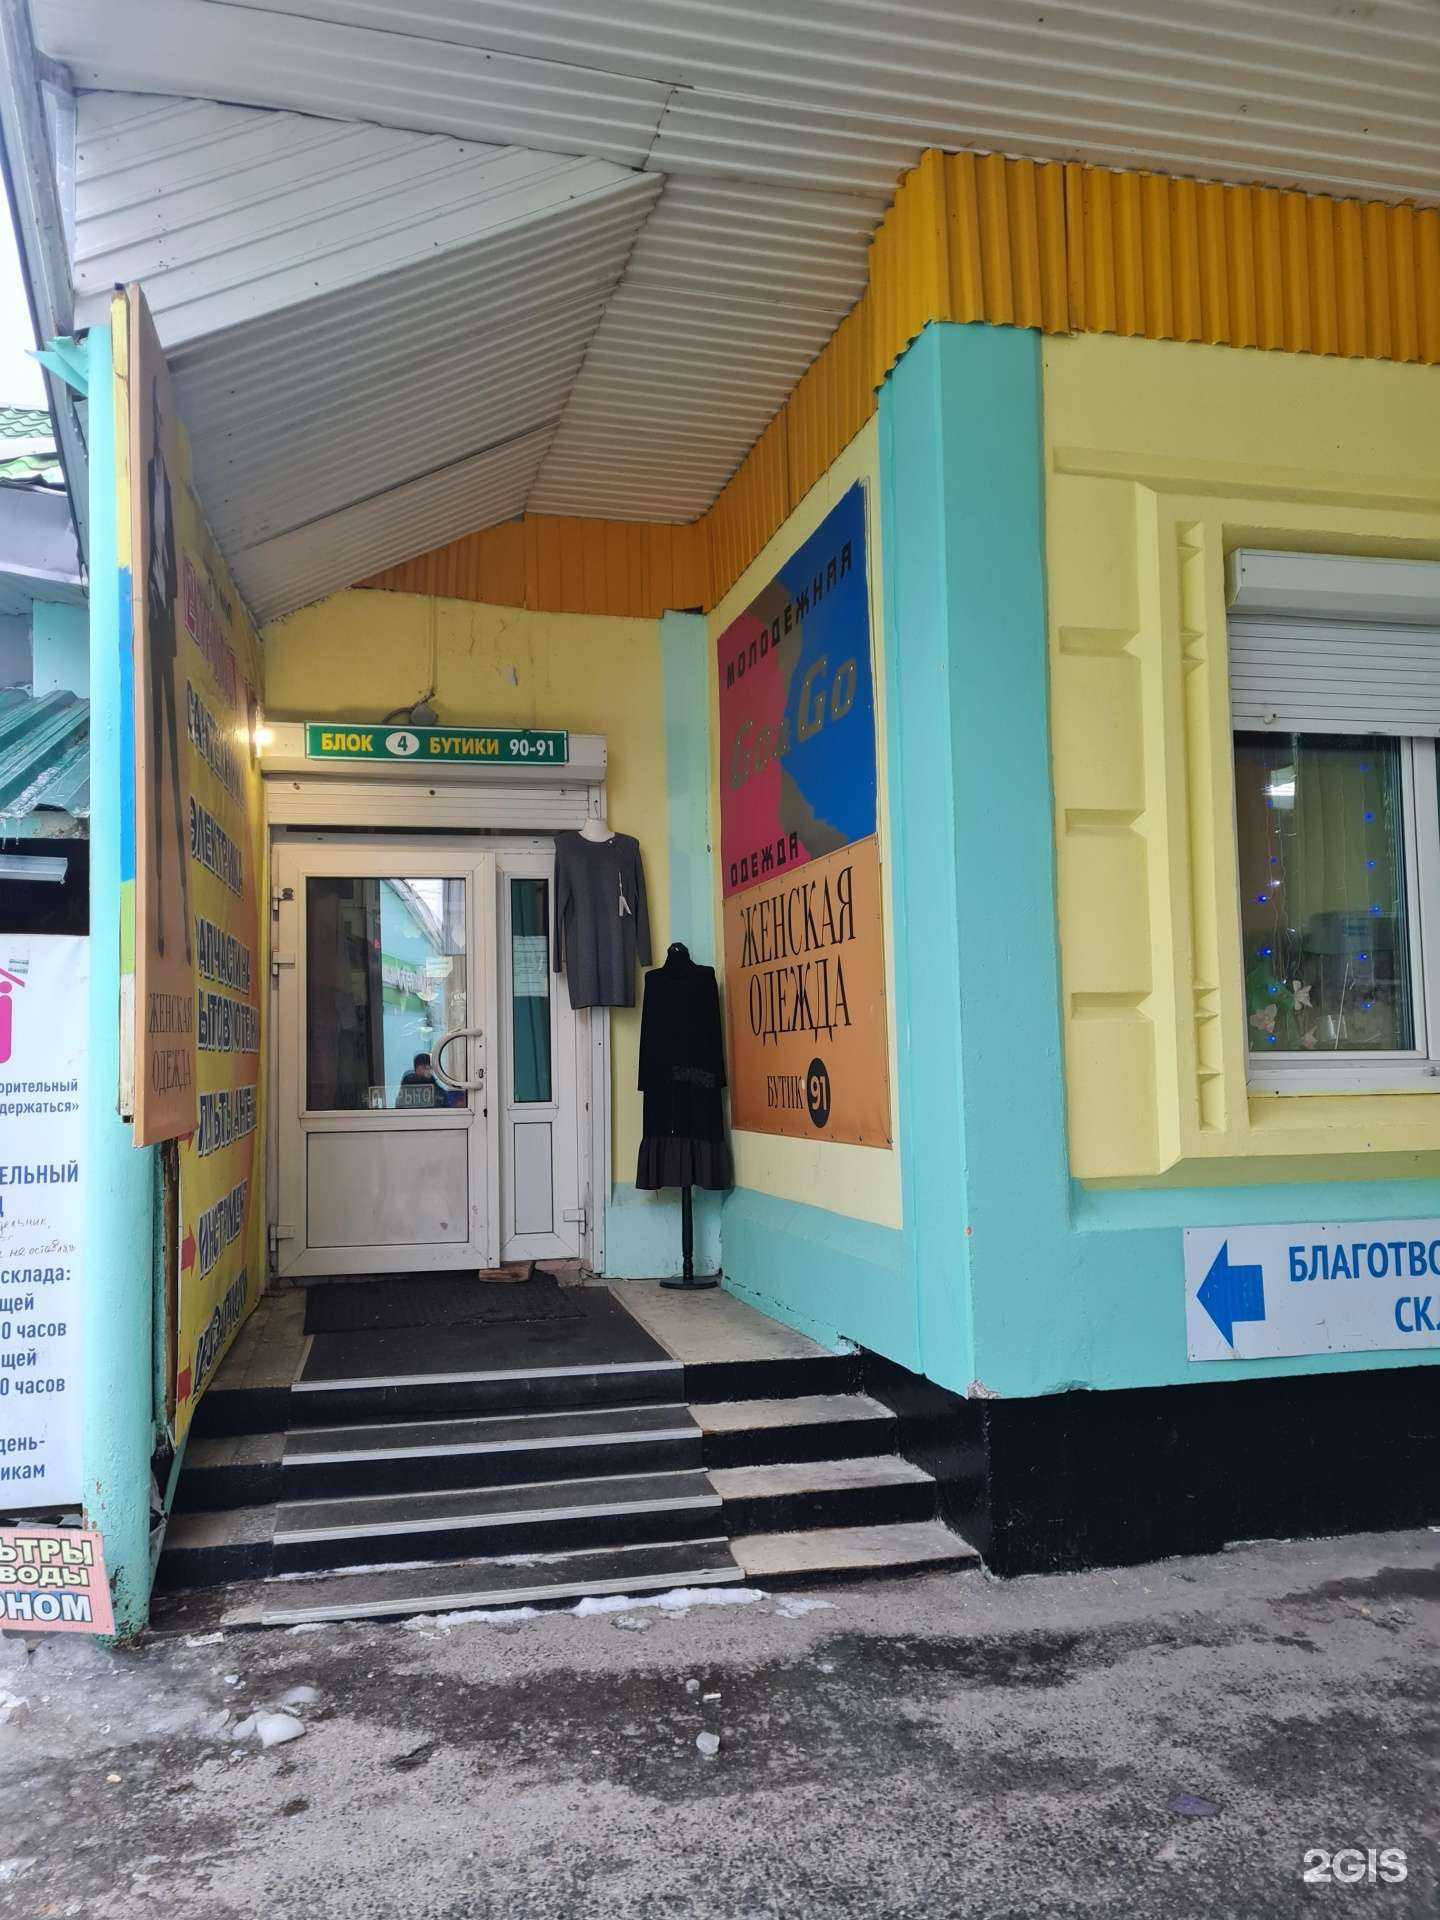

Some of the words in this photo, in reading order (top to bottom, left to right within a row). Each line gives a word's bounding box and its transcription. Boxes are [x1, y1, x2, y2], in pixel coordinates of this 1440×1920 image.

[726, 539, 852, 689] МОЛОДЕЖНАЯ
[320, 733, 373, 752] БЛОК
[396, 735, 408, 752] 4
[429, 737, 500, 756] БУТИКИ
[509, 739, 555, 757] 90-91
[731, 831, 799, 888] ОДЕЖДА
[740, 866, 857, 968] ЖЕНСКАЯ
[149, 992, 193, 1034] ЖЕНСКАЯ
[749, 954, 852, 1047] ОДЕЖДА
[152, 1050, 192, 1096] ОДЕЖДА
[766, 1075, 804, 1110] БУТИК
[810, 1076, 828, 1111] 91
[0, 1267, 71, 1285] склада:
[17, 1323, 67, 1339] часов
[1, 1347, 37, 1370] щей
[15, 1378, 66, 1395] часов
[1, 1464, 46, 1481] икам
[0, 1590, 94, 1623] НОМ
